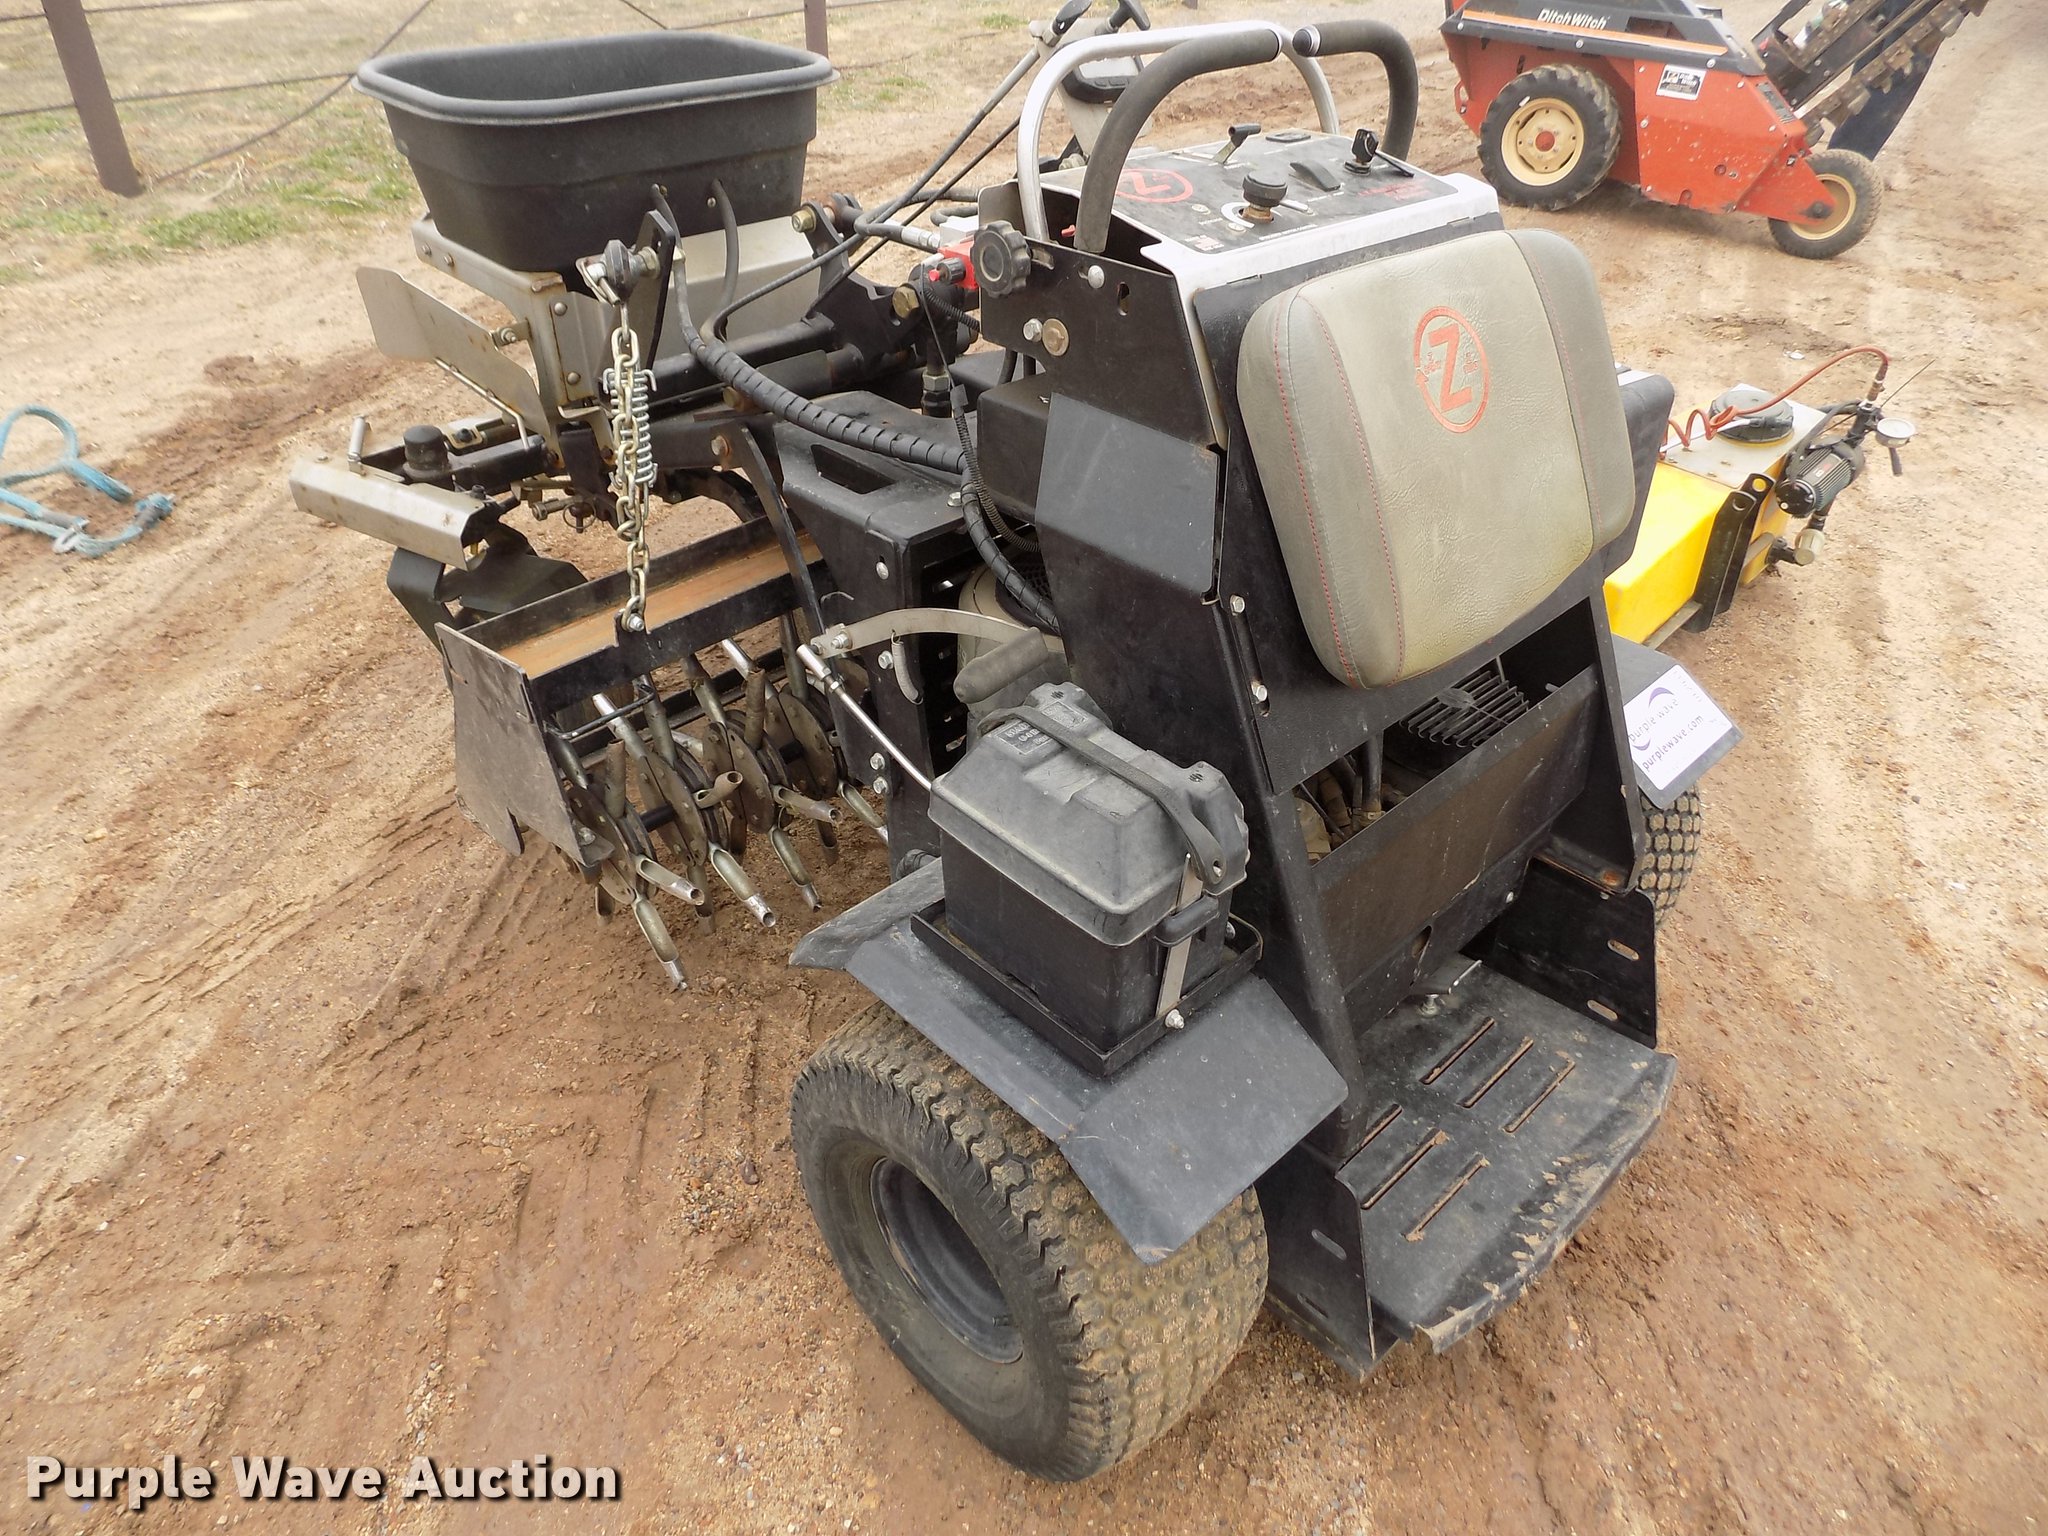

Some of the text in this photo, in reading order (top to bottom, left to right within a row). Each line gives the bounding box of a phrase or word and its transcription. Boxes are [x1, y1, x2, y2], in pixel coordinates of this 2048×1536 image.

[1538, 8, 1607, 30] Ditch Witch
[1428, 322, 1472, 412] Z
[1628, 698, 1679, 742] purple wave
[1642, 714, 1704, 772] purplewave.com
